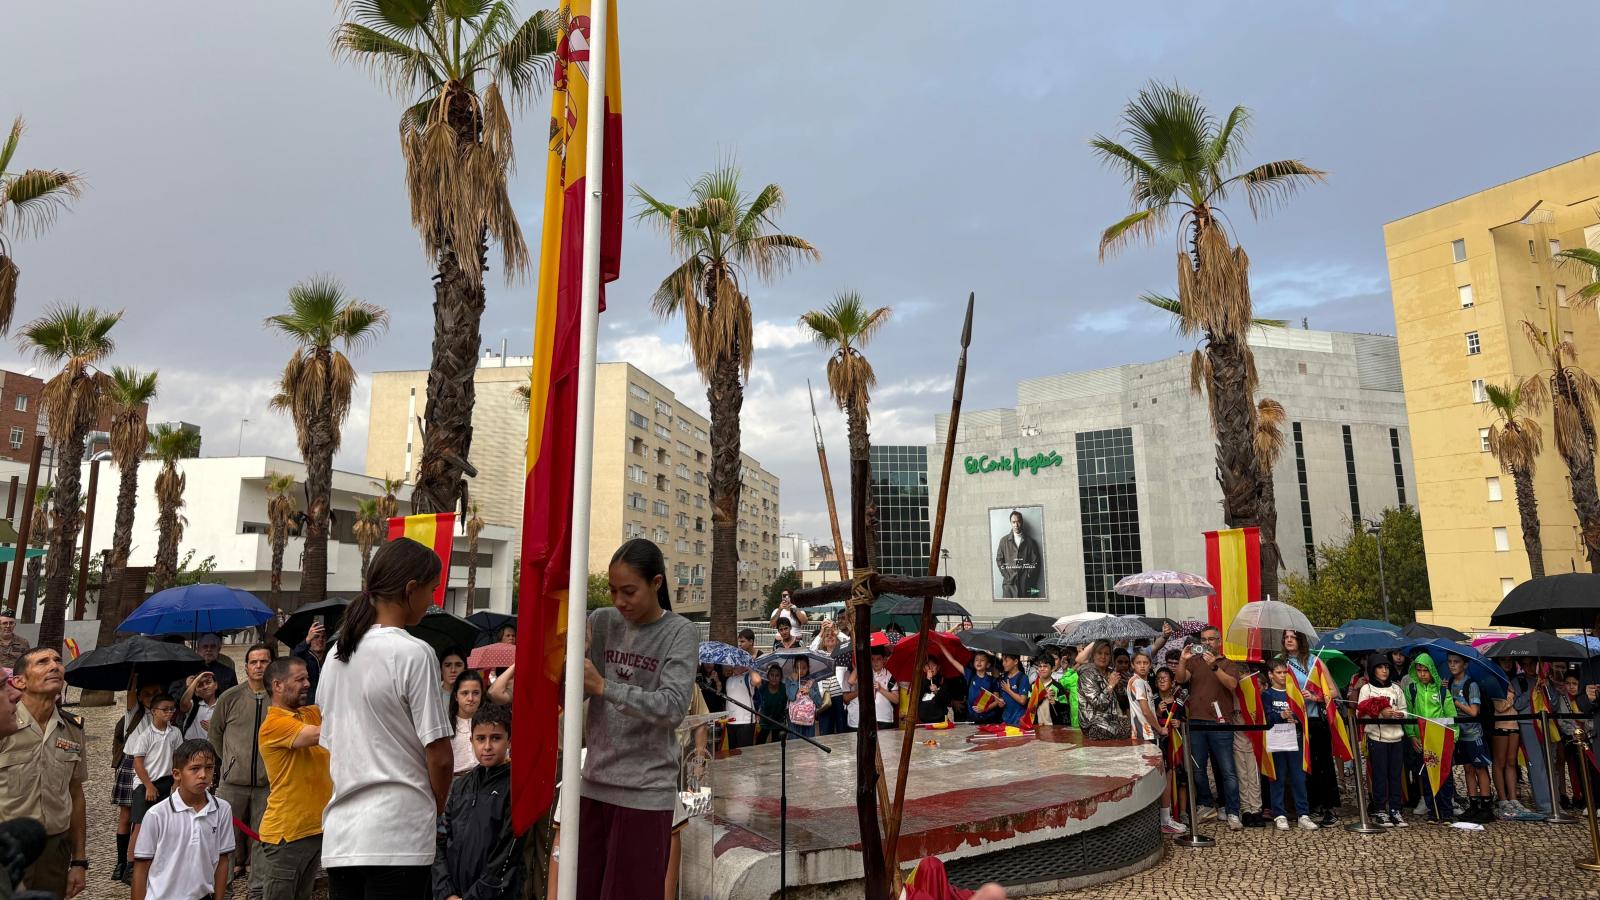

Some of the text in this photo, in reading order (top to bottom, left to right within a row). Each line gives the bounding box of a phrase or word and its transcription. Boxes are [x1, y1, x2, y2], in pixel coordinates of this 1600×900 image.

[964, 447, 1063, 477] El Corte Inglés
[602, 649, 660, 672] RINCESS
